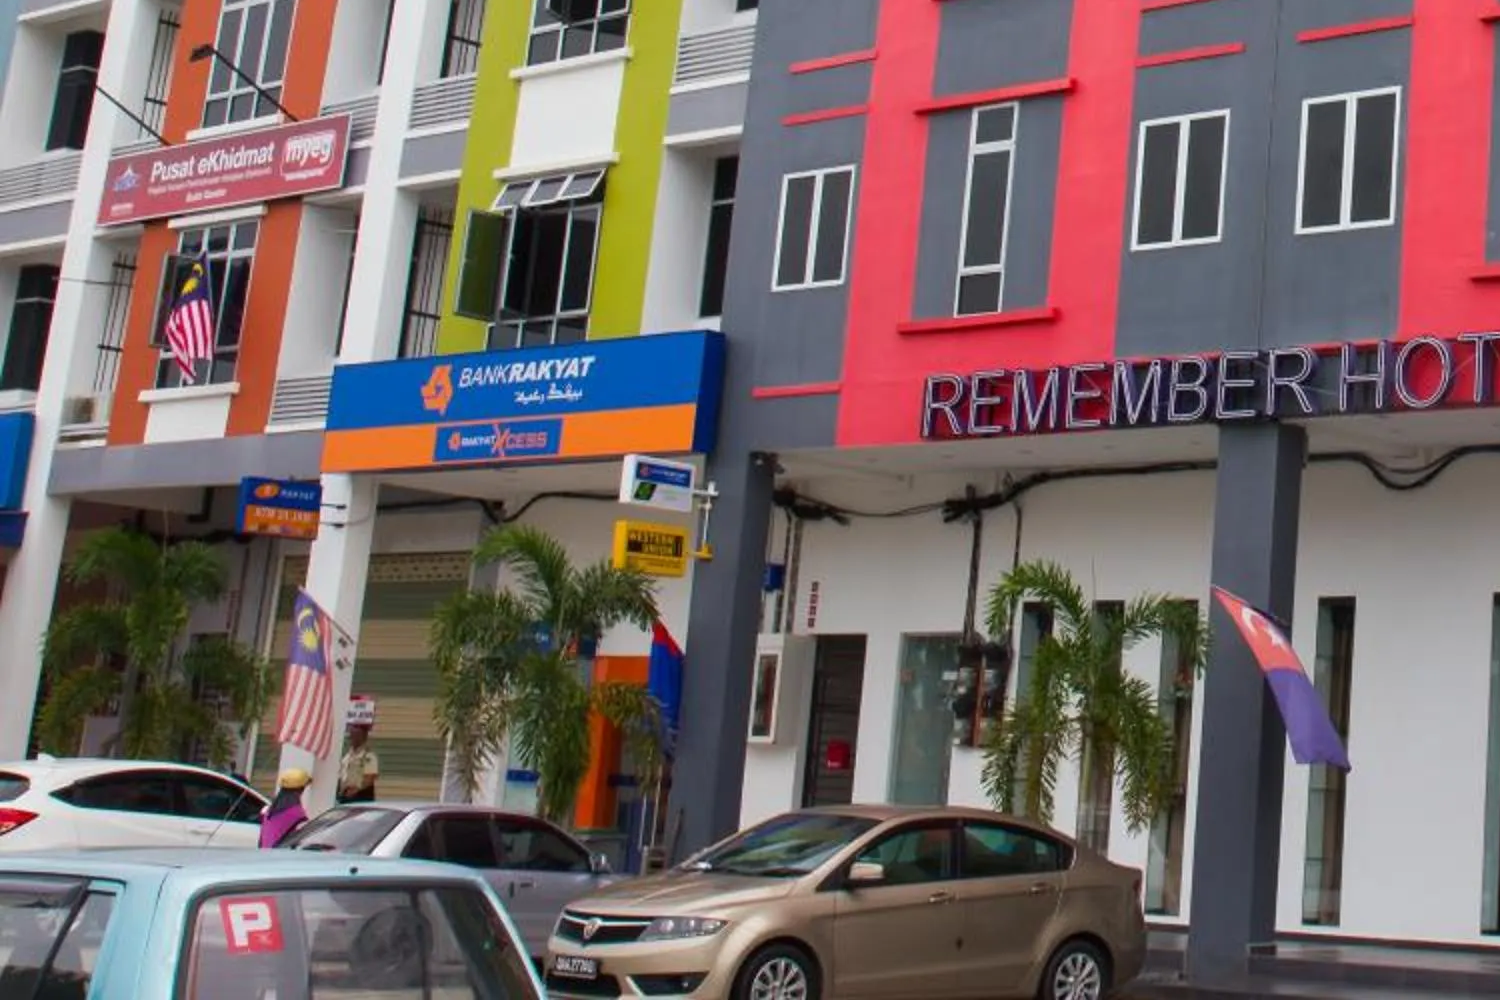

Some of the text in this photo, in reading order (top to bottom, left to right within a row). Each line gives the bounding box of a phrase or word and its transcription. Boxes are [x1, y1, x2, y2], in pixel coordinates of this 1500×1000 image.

[150, 158, 195, 184] Pusat
[198, 142, 276, 173] eKhidmat
[285, 135, 333, 168] myeg
[922, 346, 1313, 438] REMEMBER
[228, 902, 273, 947] P
